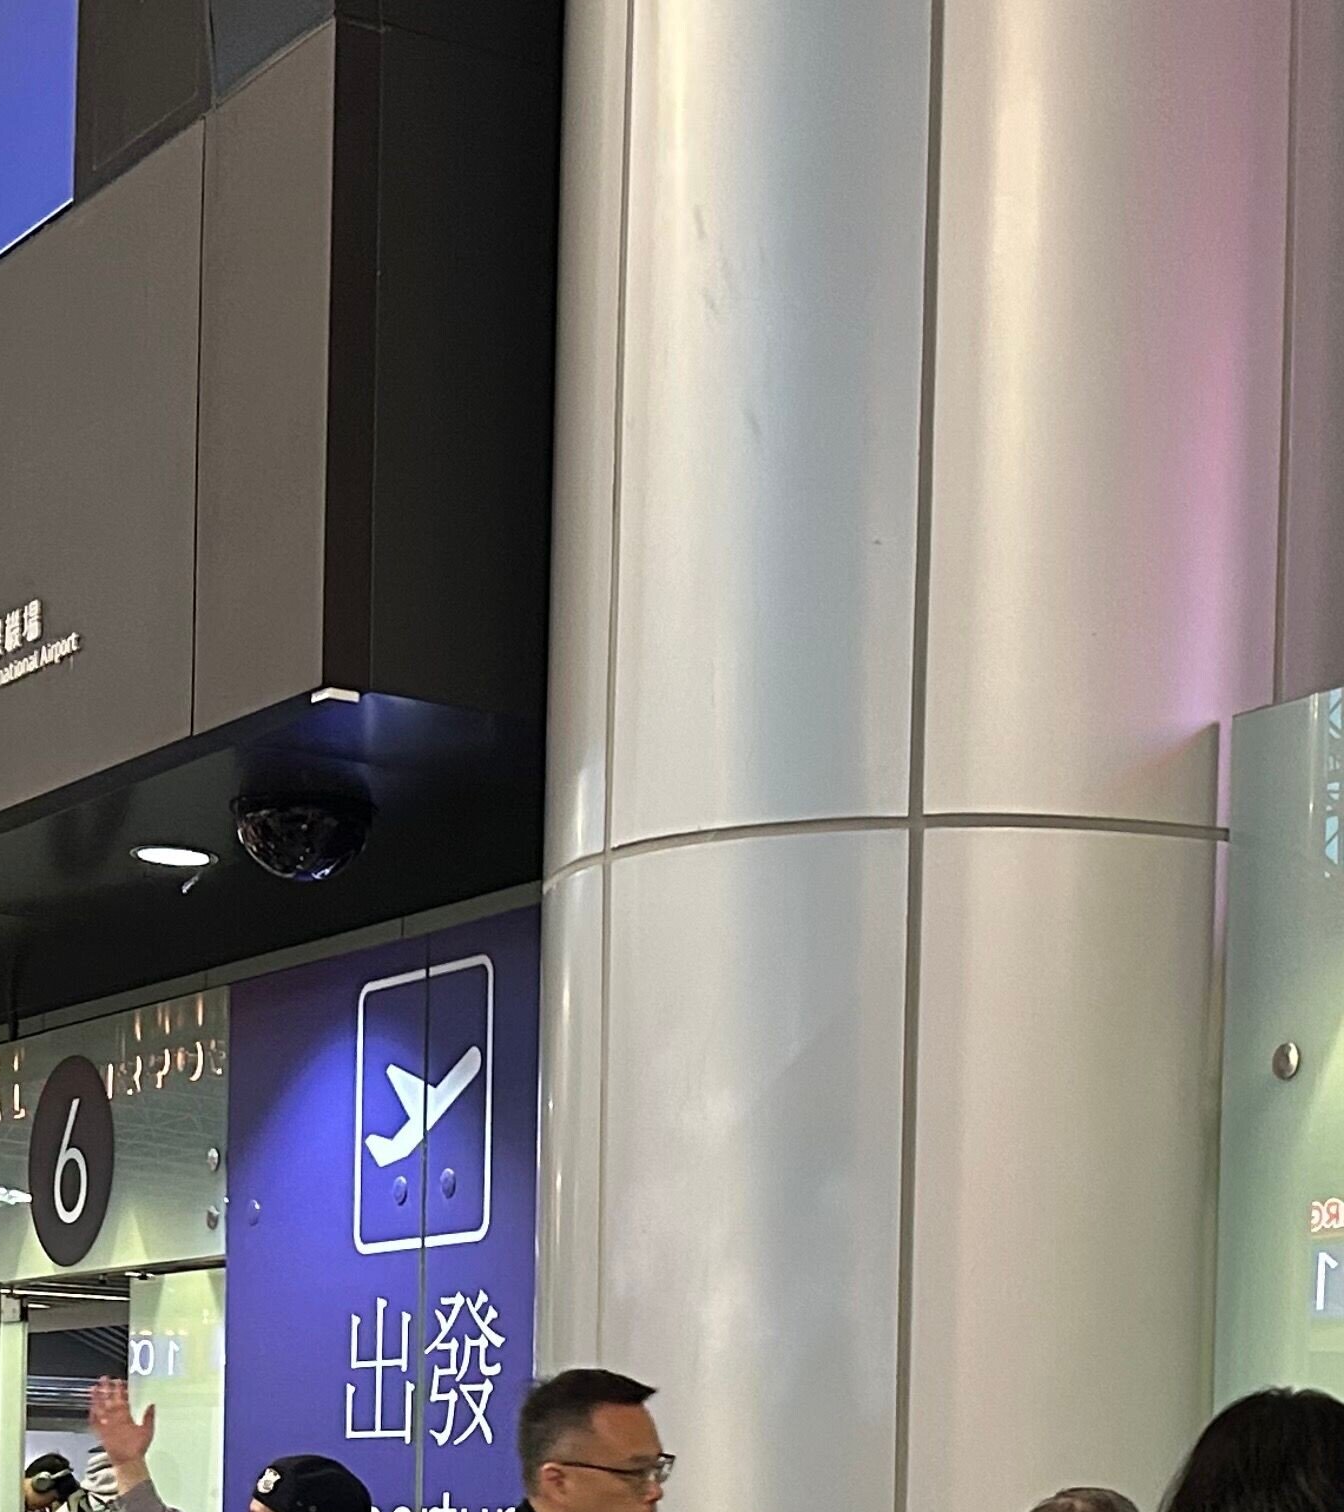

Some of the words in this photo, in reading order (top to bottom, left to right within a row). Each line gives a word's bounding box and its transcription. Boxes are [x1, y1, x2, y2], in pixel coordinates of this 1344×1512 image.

[41, 631, 80, 667] Airport
[53, 1097, 88, 1224] 6
[345, 1289, 506, 1446] 出發
